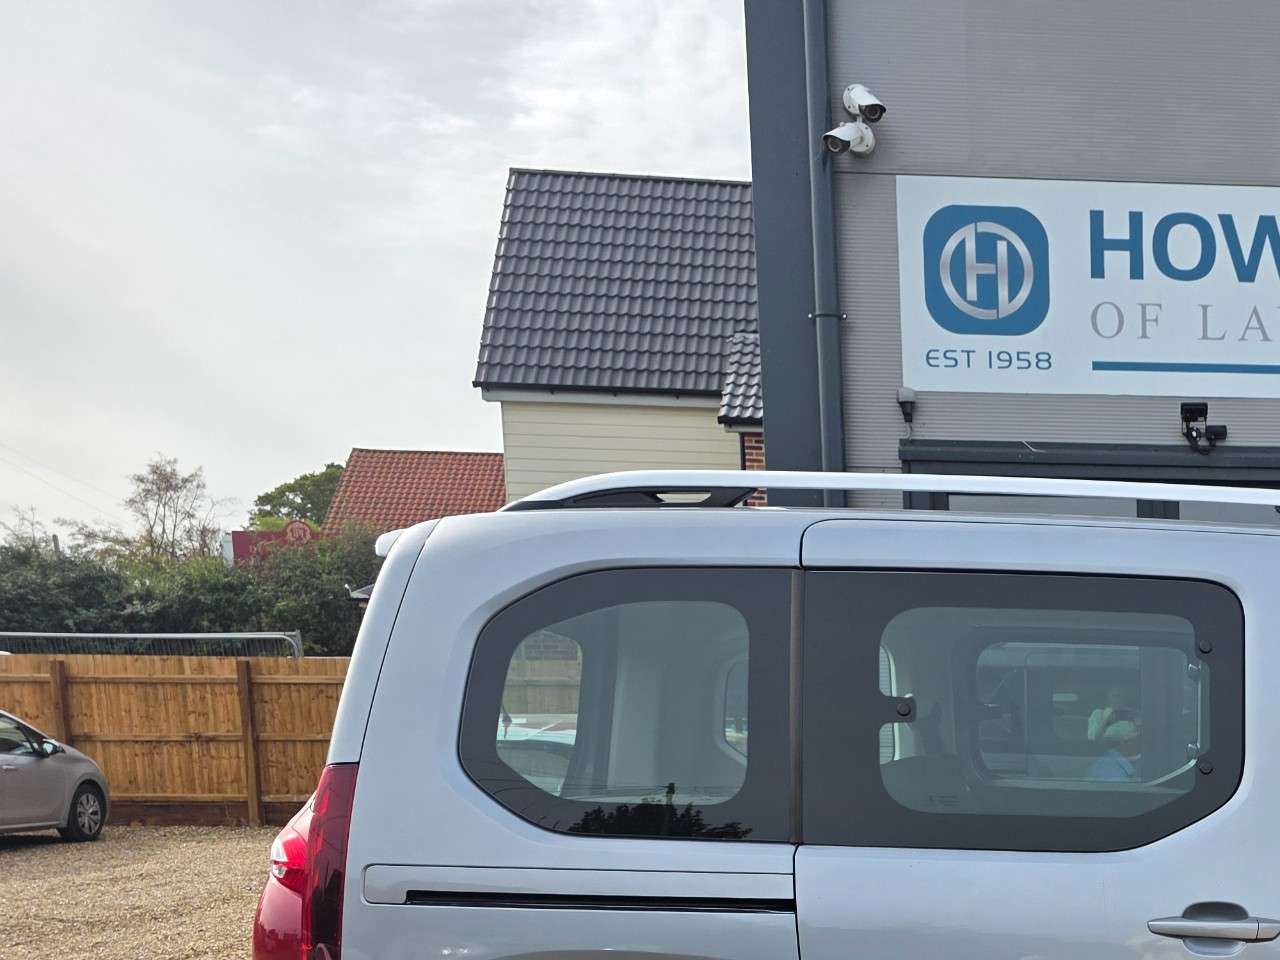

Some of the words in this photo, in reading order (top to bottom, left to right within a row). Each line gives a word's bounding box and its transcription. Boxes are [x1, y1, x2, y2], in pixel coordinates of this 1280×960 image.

[1090, 301, 1163, 340] OF
[925, 349, 976, 369] EST
[988, 350, 1053, 370] 1958
